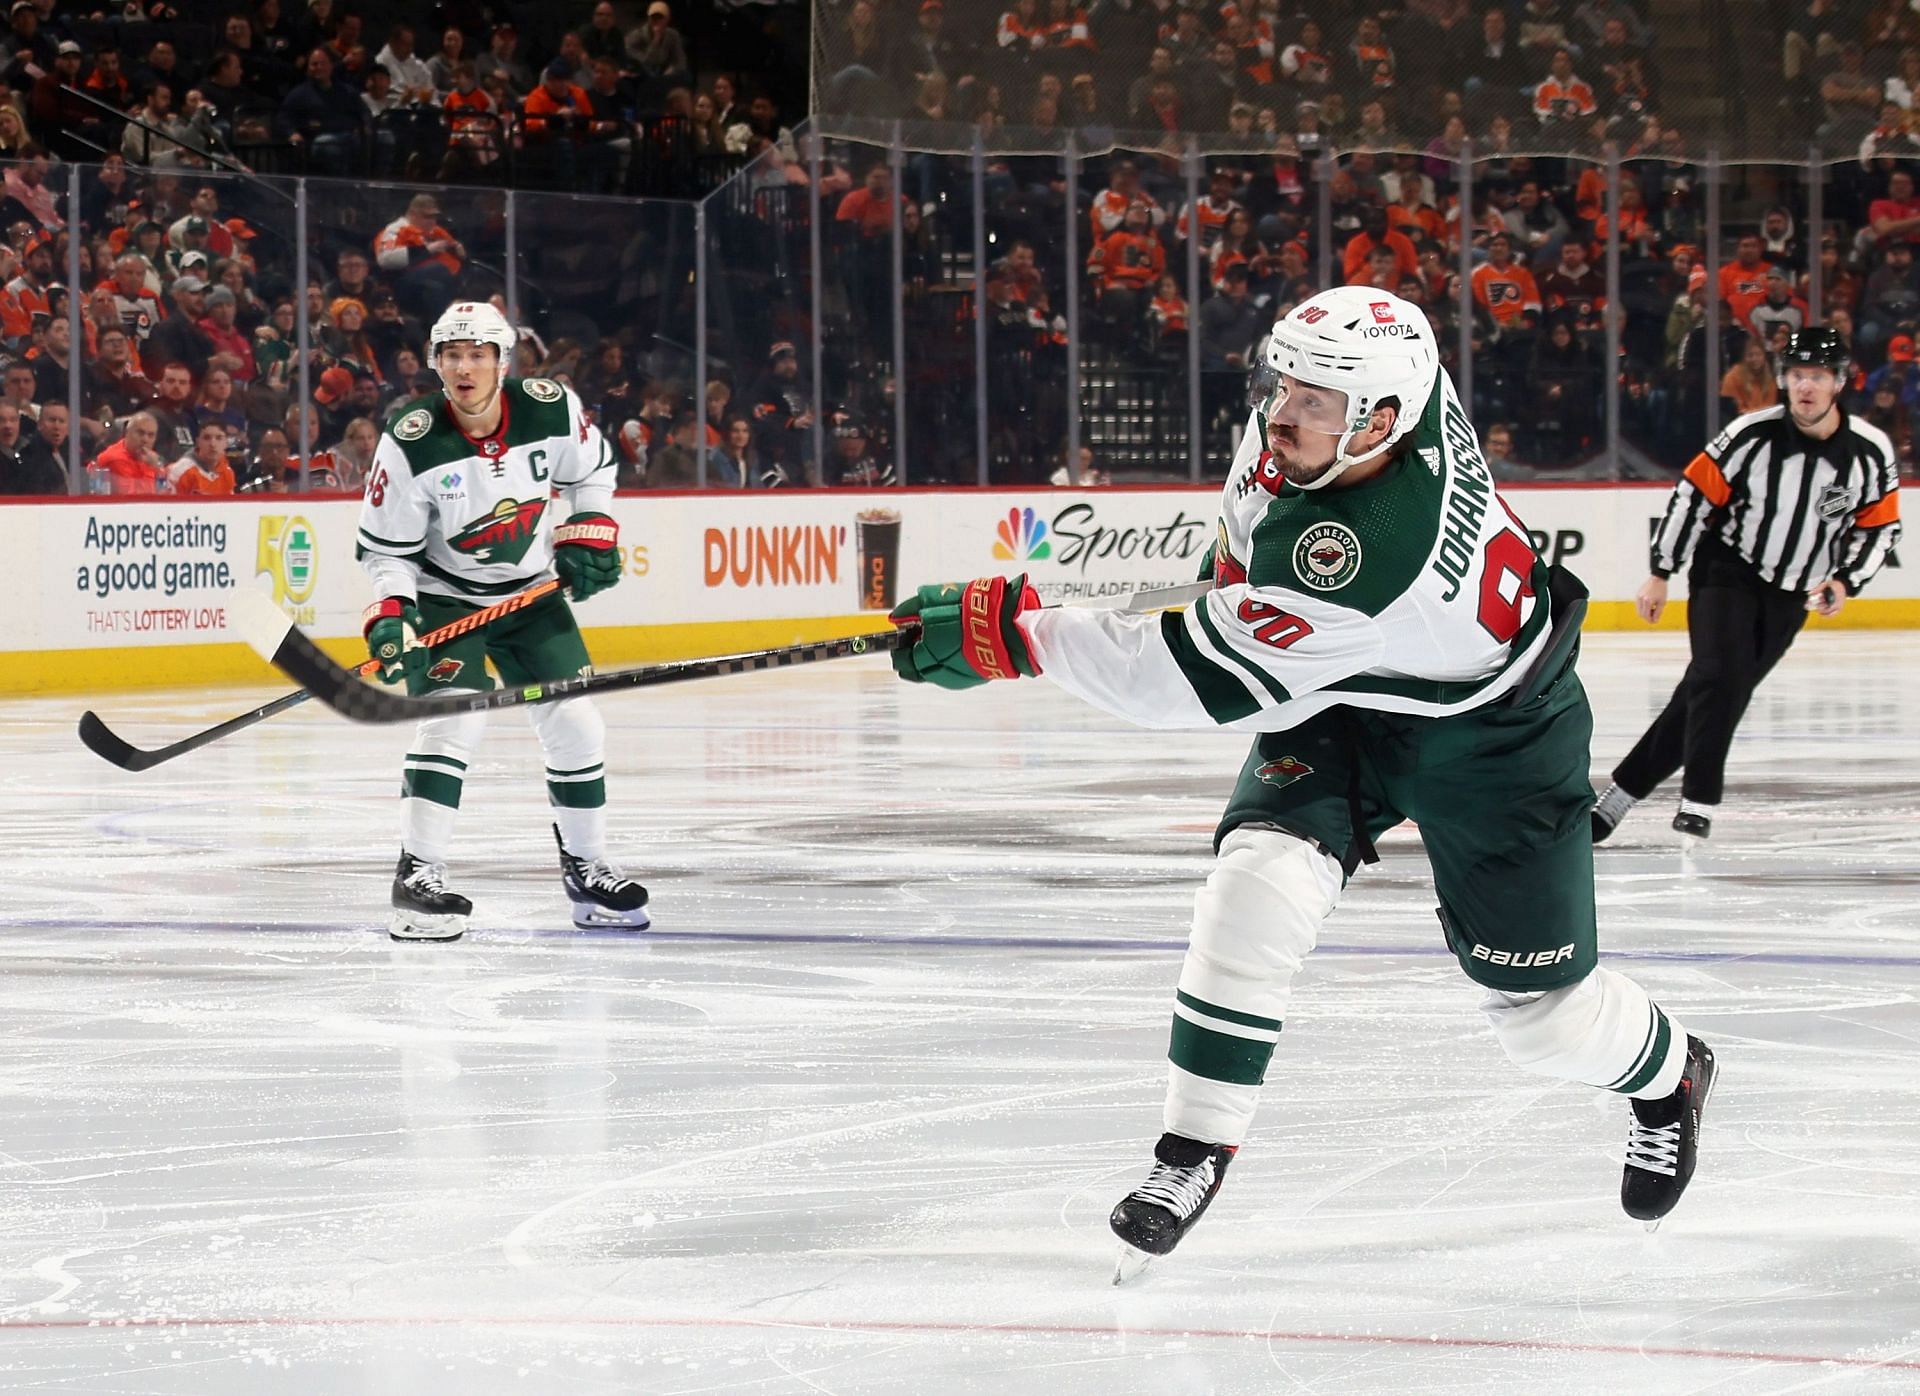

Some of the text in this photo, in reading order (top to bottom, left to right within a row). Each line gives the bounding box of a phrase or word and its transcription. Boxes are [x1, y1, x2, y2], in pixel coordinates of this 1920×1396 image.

[1296, 305, 1329, 325] 90
[1359, 324, 1414, 340] TOYOTA
[528, 450, 549, 482] C
[439, 491, 466, 501] TRIA
[84, 516, 227, 554] Appreciating
[1051, 502, 1207, 577] Sports
[1301, 527, 1357, 558] MINNESOTA
[704, 524, 846, 588] DUNKIN'
[77, 554, 236, 598] a good game.
[1305, 570, 1336, 587] WILD
[87, 608, 226, 633] THAT'S LOTTERY LOVE
[1237, 597, 1315, 650] 90
[1471, 941, 1576, 968] BAUER
